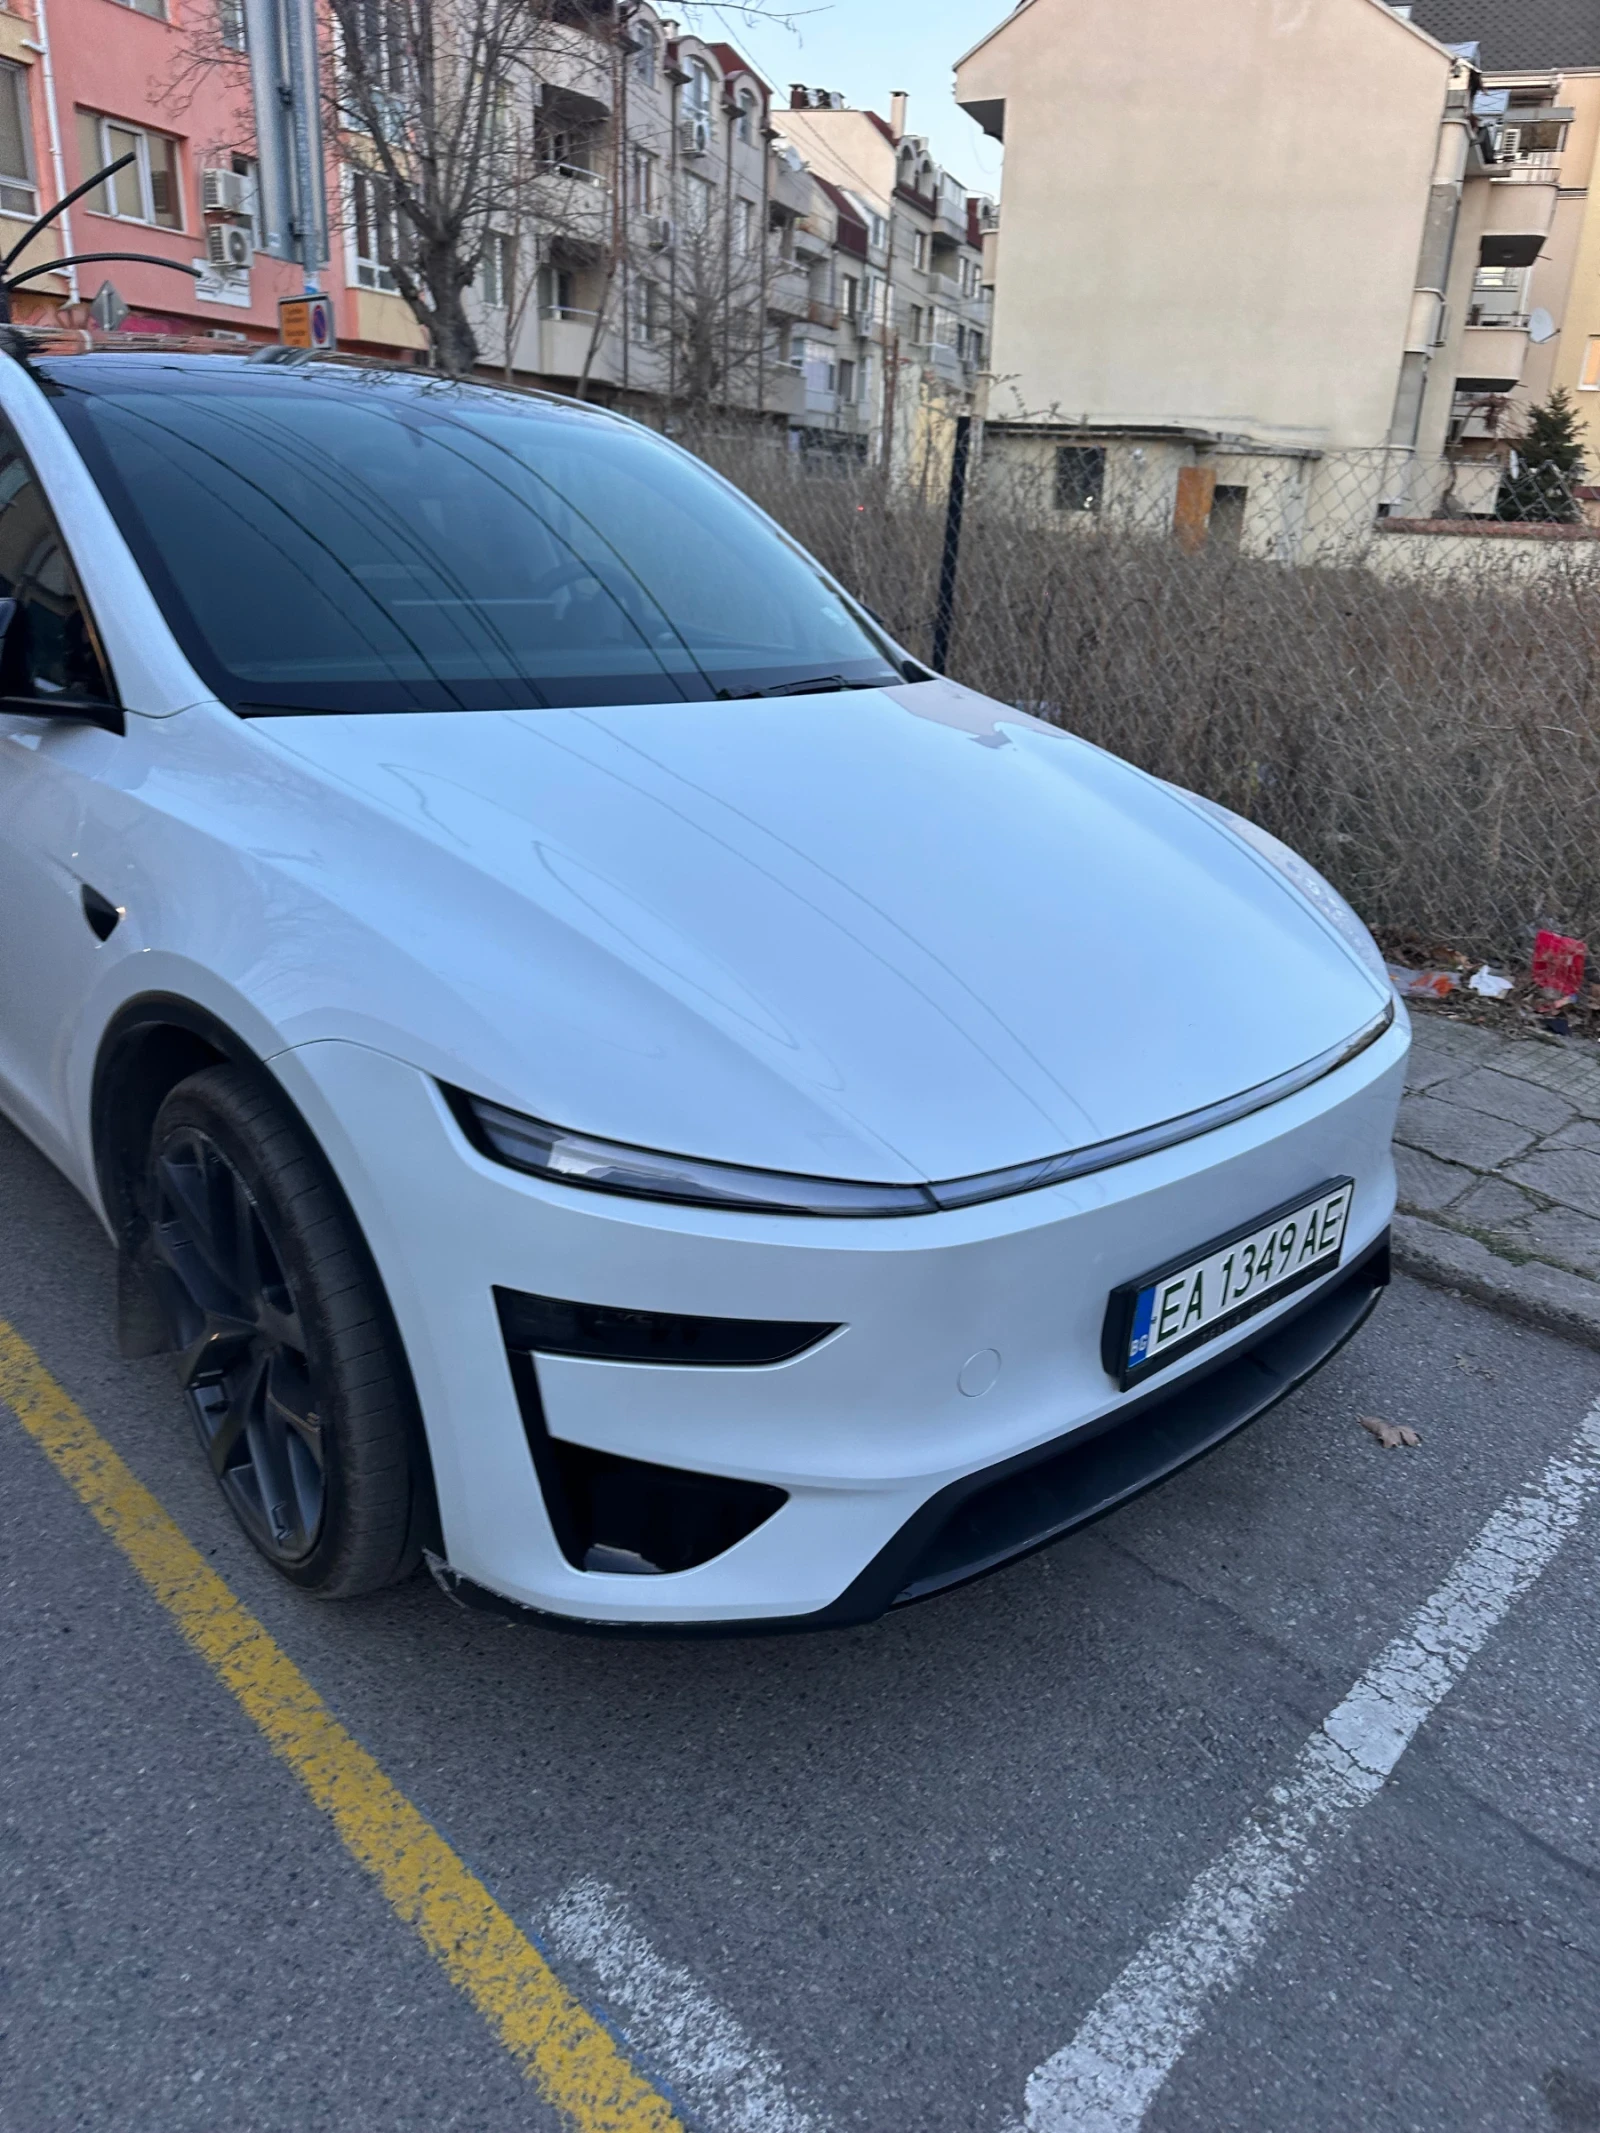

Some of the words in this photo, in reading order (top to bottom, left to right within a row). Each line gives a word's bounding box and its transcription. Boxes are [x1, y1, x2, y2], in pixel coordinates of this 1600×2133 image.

[1157, 1269, 1204, 1343] EA
[1221, 1221, 1297, 1307] 1349
[1298, 1195, 1344, 1263] AE
[1130, 1334, 1149, 1357] BG
